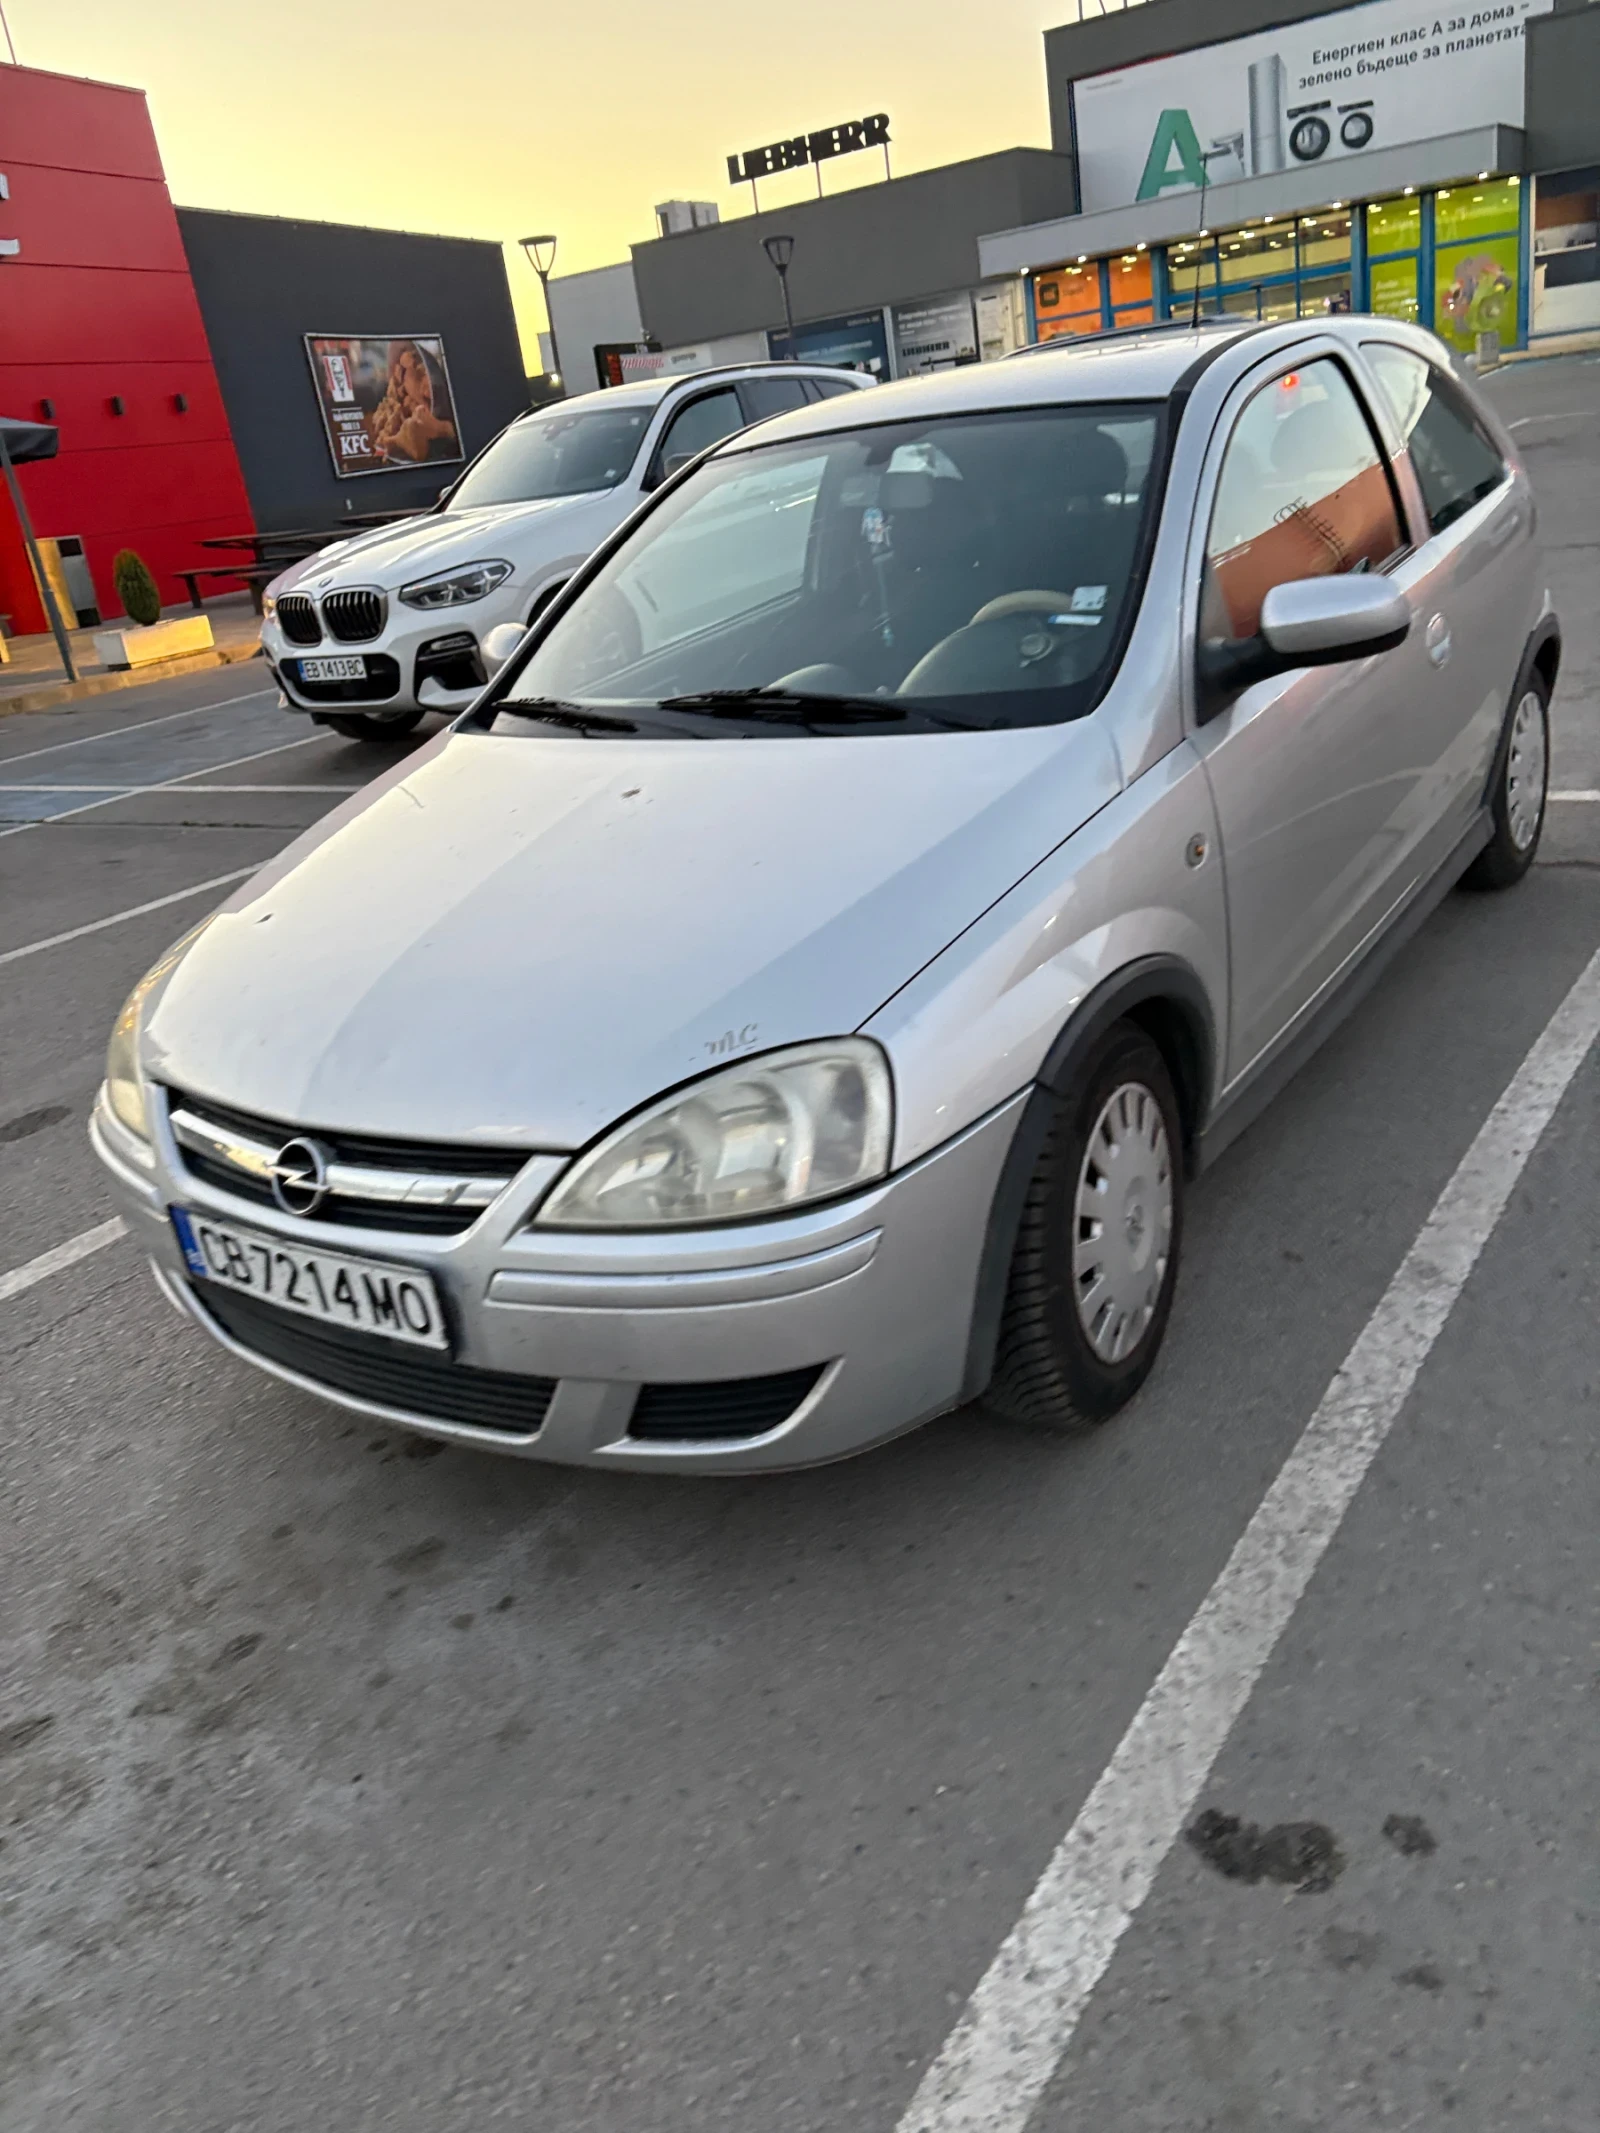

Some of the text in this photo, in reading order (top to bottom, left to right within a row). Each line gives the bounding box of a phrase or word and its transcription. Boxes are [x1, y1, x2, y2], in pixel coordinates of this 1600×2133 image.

[1312, 38, 1385, 65] Енергиен
[1390, 28, 1427, 47] клас
[1447, 16, 1466, 32] за
[1470, 6, 1515, 29] дома
[1299, 65, 1352, 89] зелено
[1356, 51, 1418, 75] бъдеще
[1422, 44, 1441, 61] за
[339, 434, 371, 456] KFC
